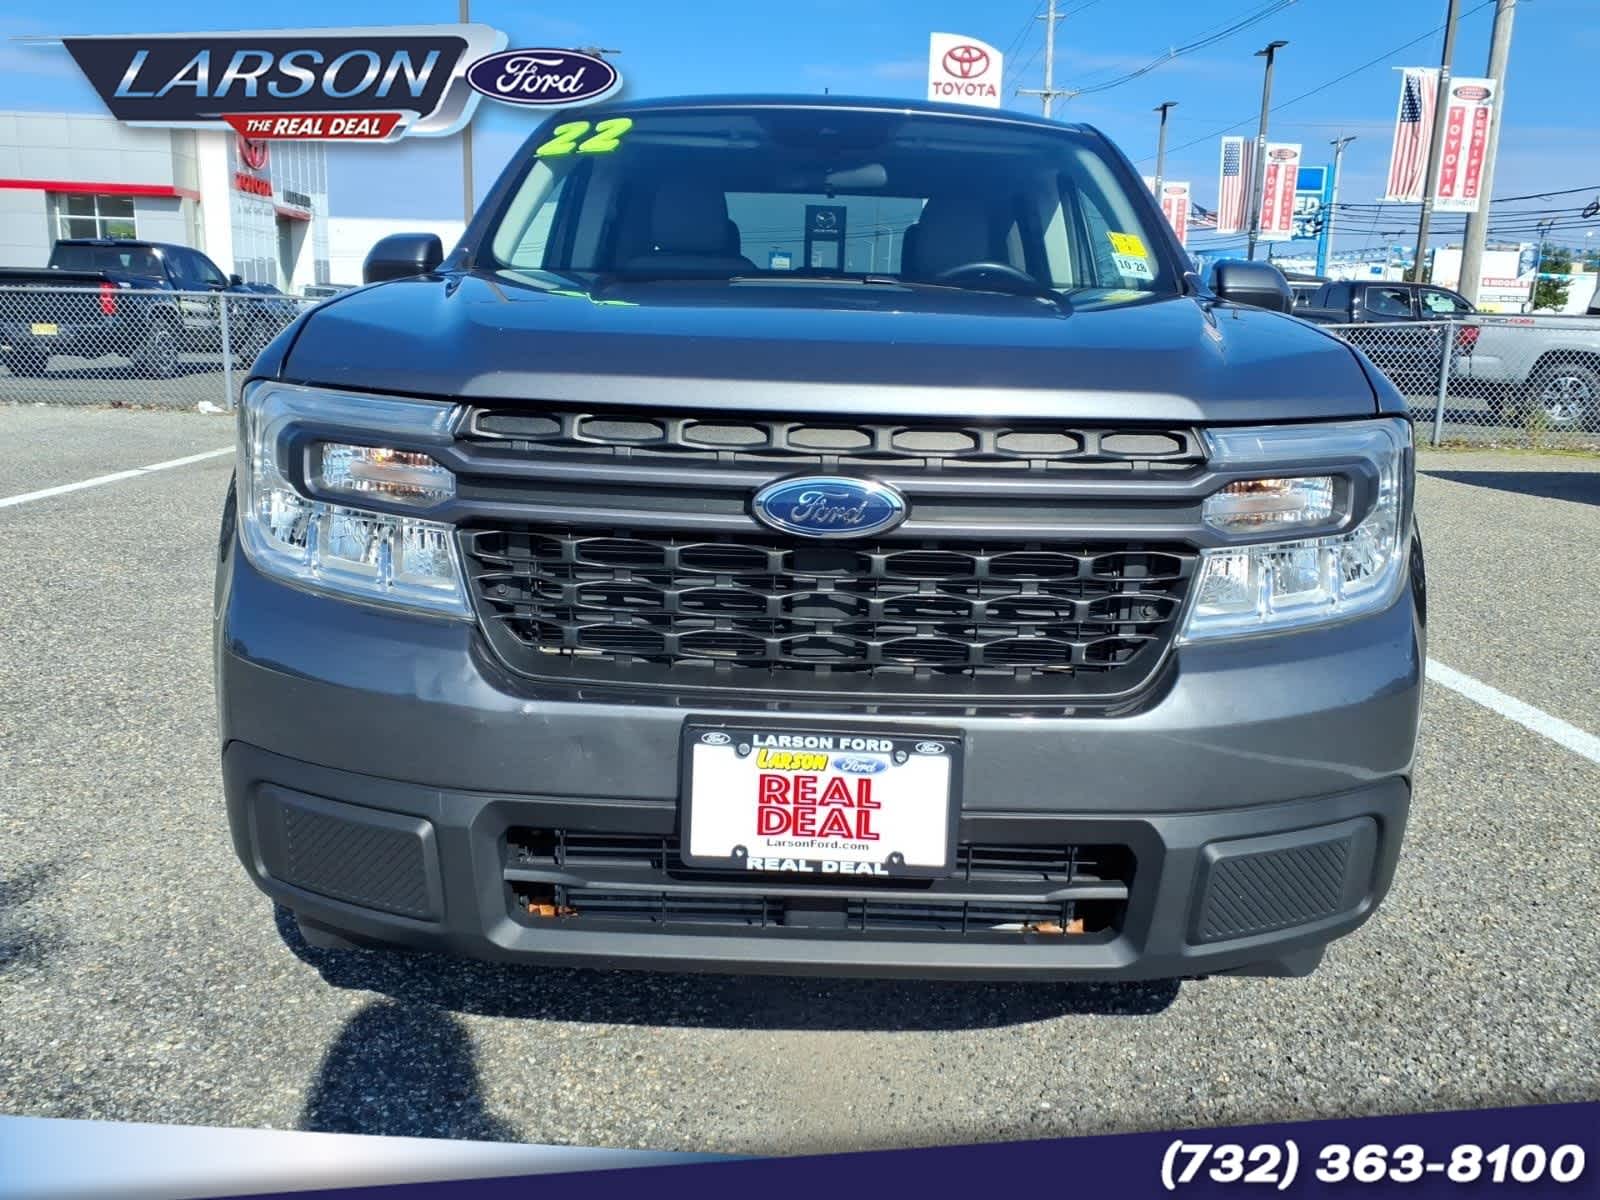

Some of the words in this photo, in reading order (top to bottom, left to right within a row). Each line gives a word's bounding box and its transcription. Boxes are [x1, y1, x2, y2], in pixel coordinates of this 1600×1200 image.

[933, 82, 996, 96] TOYOTA
[533, 118, 633, 158] 22
[1441, 109, 1460, 194] TOYOTA
[1465, 108, 1487, 197] CERTIFIED
[1263, 165, 1276, 228] TOYOTA
[789, 489, 872, 526] Ford
[753, 734, 834, 750] LARSON
[840, 737, 893, 751] FORD
[841, 755, 878, 774] Ford
[758, 774, 881, 809] REAL
[757, 806, 880, 840] DEAL
[766, 838, 870, 851] LarsonFord.com
[747, 857, 814, 872] REAL
[822, 859, 889, 875] DEAL
